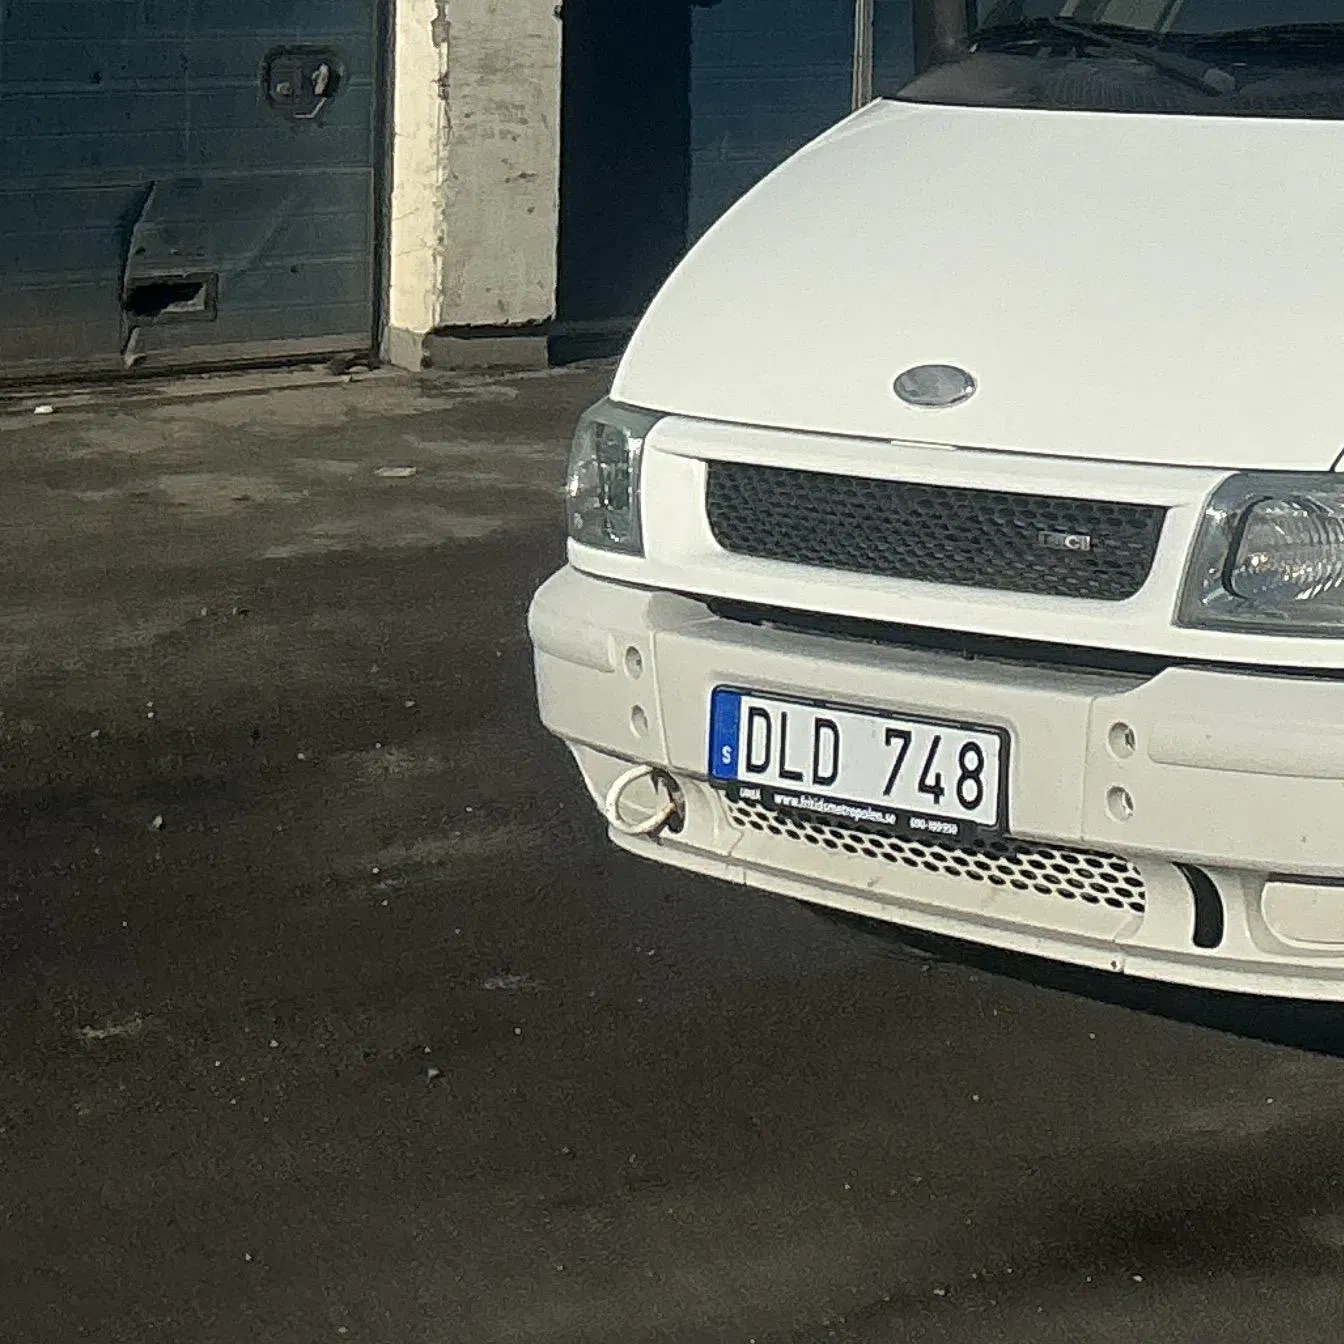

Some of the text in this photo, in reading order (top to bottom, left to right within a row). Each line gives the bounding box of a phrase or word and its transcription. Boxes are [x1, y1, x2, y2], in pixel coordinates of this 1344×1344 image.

[722, 745, 732, 765] S
[745, 706, 985, 810] DLD 748
